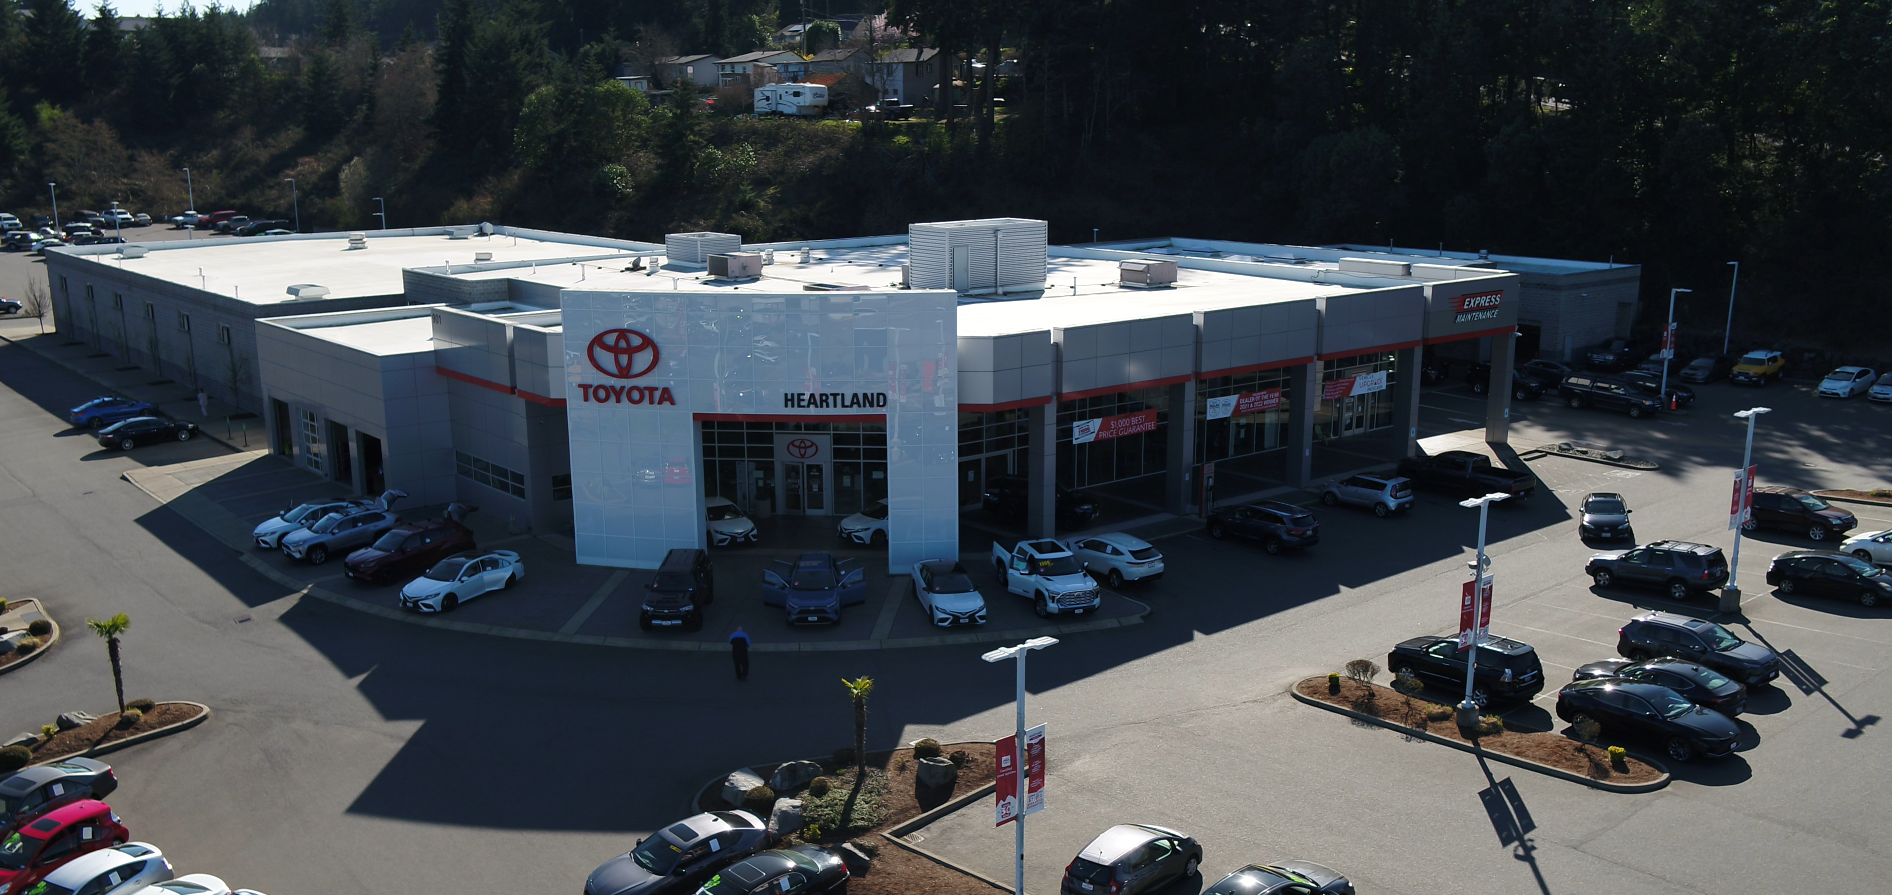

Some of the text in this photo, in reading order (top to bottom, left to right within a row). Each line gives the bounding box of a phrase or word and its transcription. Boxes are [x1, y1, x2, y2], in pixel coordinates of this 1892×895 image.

[1463, 294, 1501, 309] EXPRESS
[1456, 310, 1498, 323] MAINTENANCE
[578, 383, 676, 406] TOYOTA
[784, 392, 887, 409] HEARTLAND
[1098, 421, 1155, 439] PRICE GUARANTEE
[1110, 415, 1146, 429] $1,000 BEST
